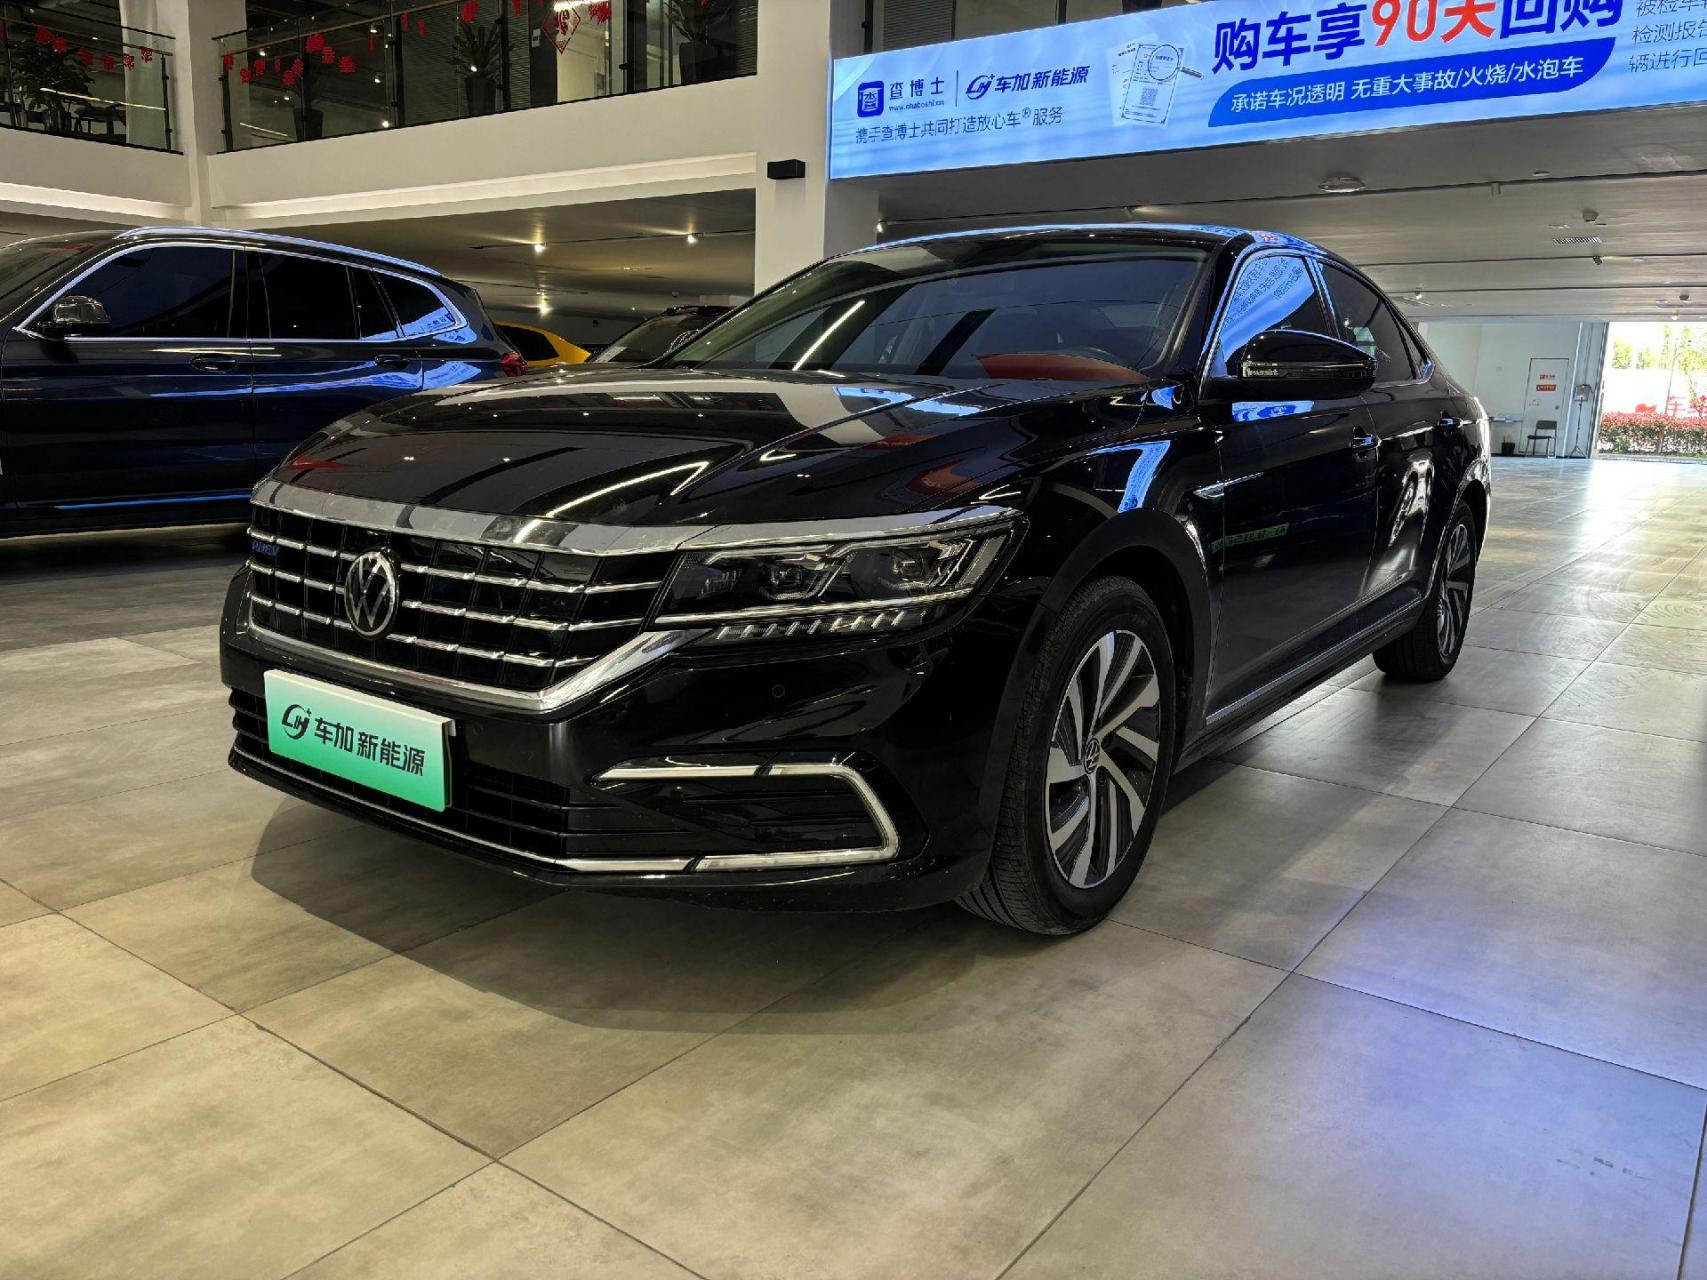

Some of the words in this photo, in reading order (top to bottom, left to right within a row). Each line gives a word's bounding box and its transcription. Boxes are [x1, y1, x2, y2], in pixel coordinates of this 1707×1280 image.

[1636, 0, 1707, 17] 被检车
[1212, 0, 1622, 74] 购车享90天回购
[889, 76, 945, 101] 查博士
[995, 65, 1090, 93] 车加新能源
[1231, 81, 1346, 113] 承诺车况透明
[1351, 56, 1584, 99] 无重大事故/火烧/水泡车
[314, 717, 426, 777] 车加新能源
